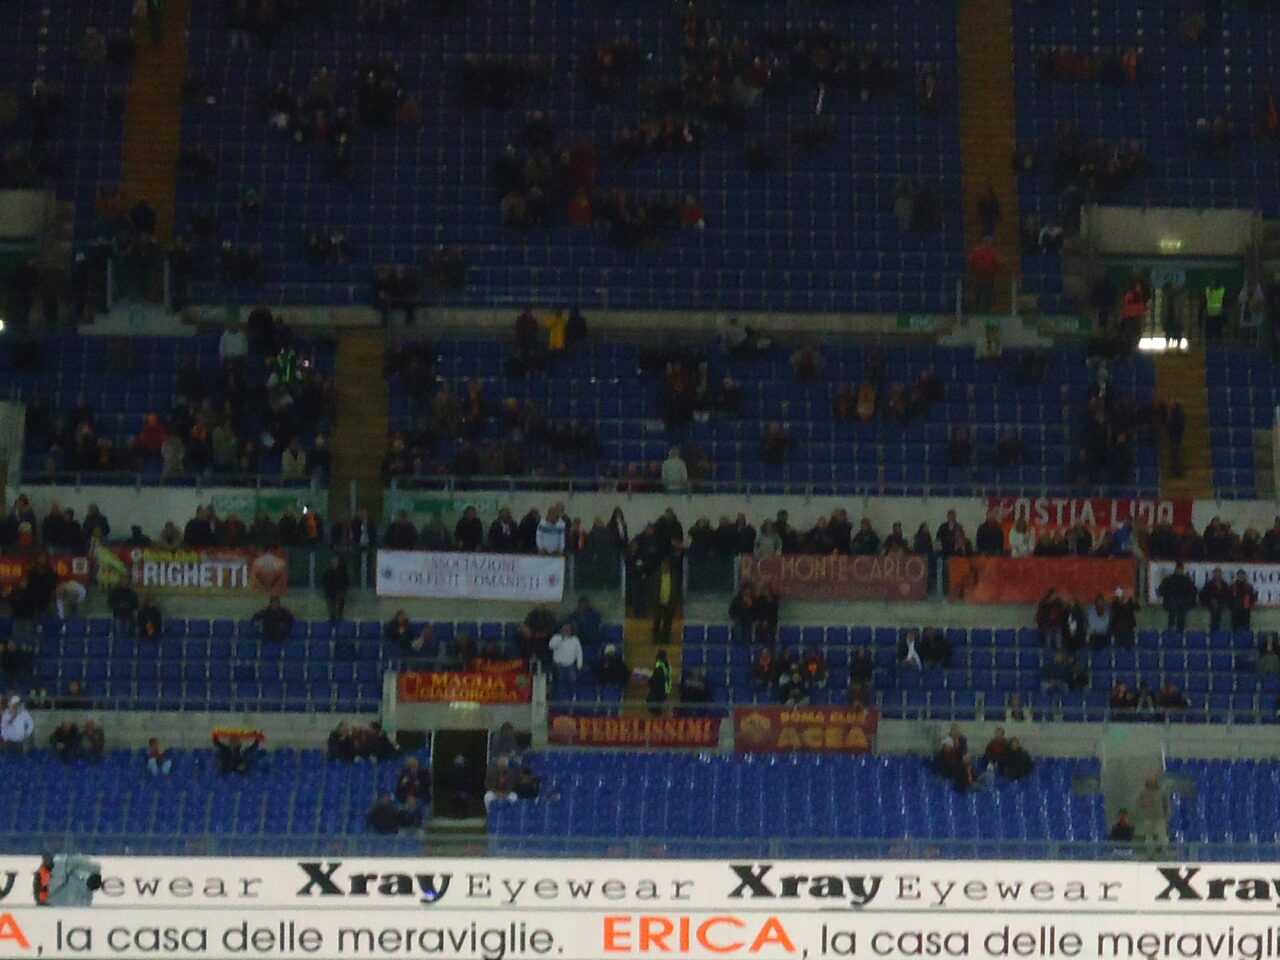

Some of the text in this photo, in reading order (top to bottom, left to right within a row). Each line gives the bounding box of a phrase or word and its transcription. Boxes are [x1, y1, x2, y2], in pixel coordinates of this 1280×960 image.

[100, 876, 265, 898] ewear
[297, 861, 696, 904] Xray Eyewear
[728, 864, 1123, 907] Xray Eyewear
[55, 920, 93, 952] la
[107, 928, 208, 952] casa
[221, 920, 323, 952] delle
[603, 915, 809, 960] ERICA,
[820, 922, 859, 955] la
[870, 929, 972, 956] casa
[983, 922, 1083, 957] delle
